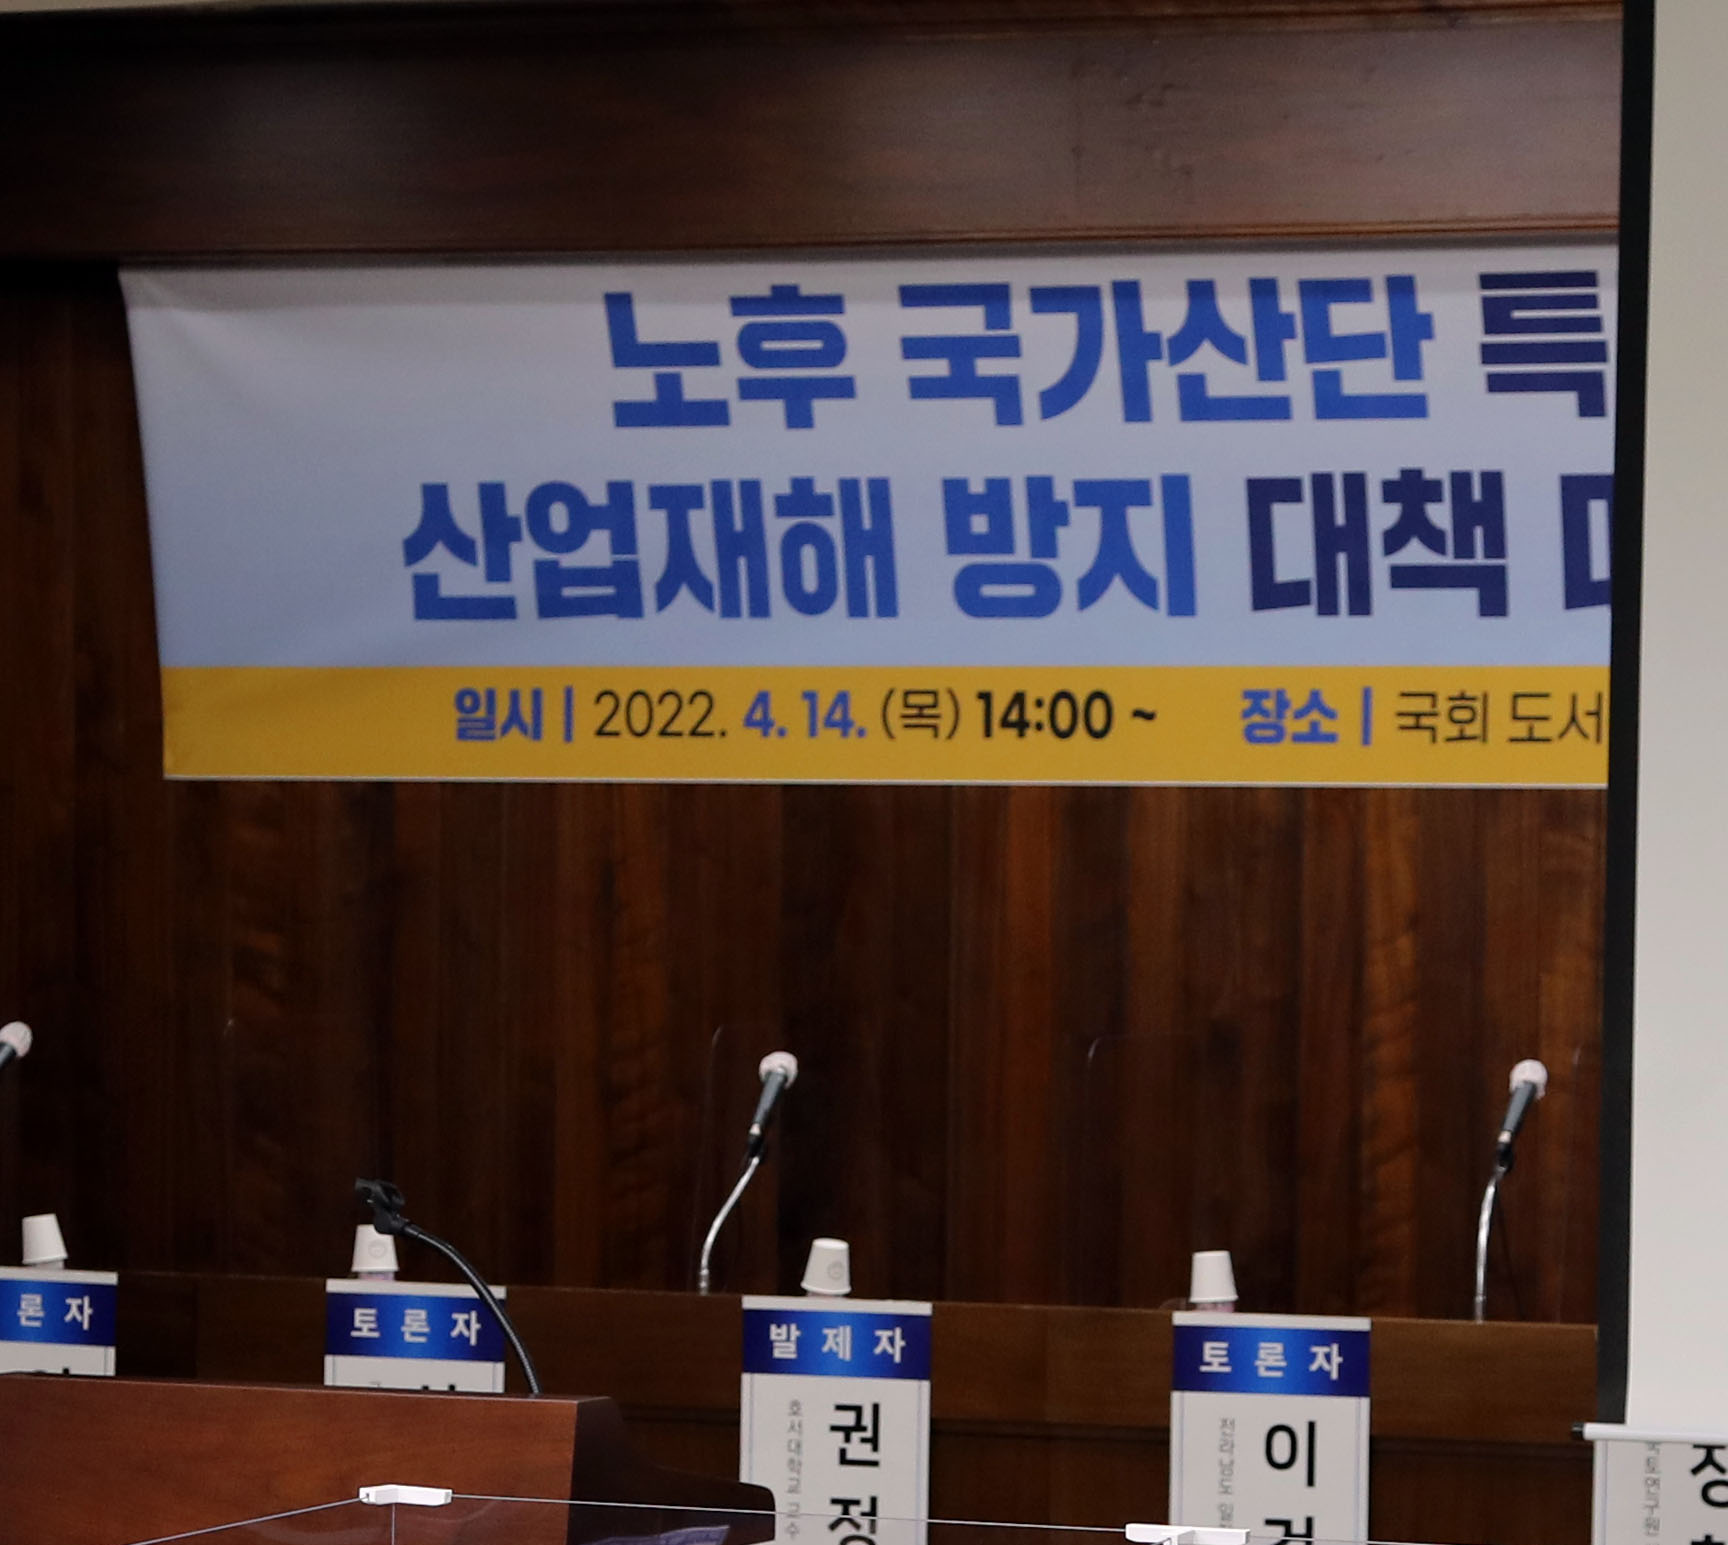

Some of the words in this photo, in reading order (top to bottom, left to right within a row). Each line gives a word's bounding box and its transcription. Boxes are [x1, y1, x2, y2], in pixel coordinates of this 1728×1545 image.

[603, 283, 858, 430] 노후
[897, 271, 1435, 428] 국가산단
[1478, 270, 1609, 418] 특
[400, 476, 901, 623] 산업재해
[941, 471, 1199, 621] 방지
[1245, 467, 1509, 618] 대책
[453, 686, 544, 742] 일시
[593, 689, 728, 738] 2022.
[881, 687, 962, 742] (목)
[1239, 687, 1340, 746] 장소
[1395, 690, 1490, 745] 국회
[1507, 690, 1605, 745] 도서
[350, 1308, 482, 1347] 토론자
[769, 1323, 907, 1364] 발제자
[1198, 1341, 1344, 1381] 토론자
